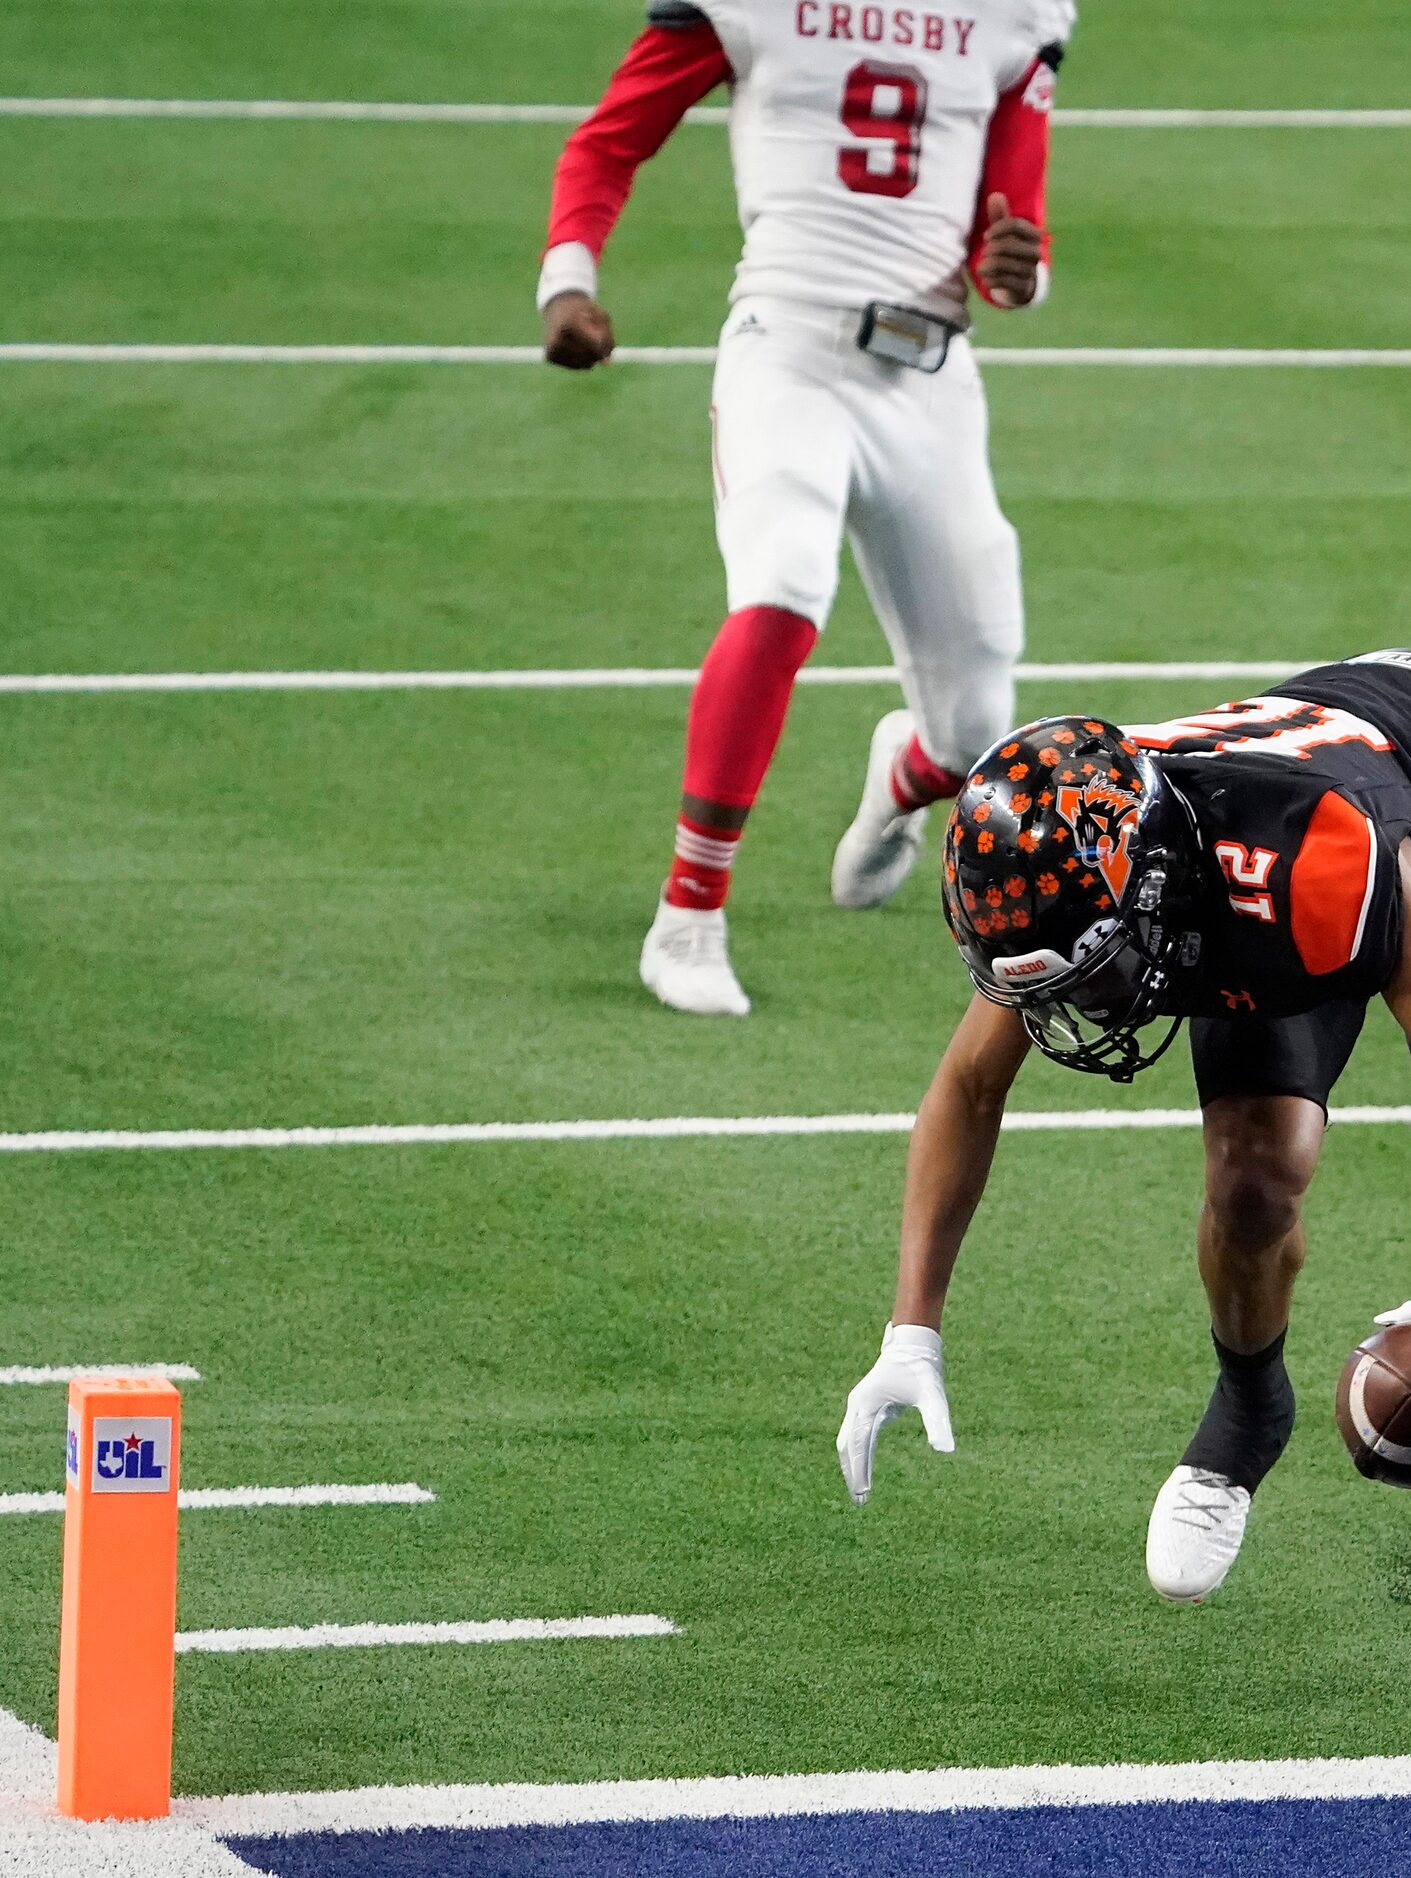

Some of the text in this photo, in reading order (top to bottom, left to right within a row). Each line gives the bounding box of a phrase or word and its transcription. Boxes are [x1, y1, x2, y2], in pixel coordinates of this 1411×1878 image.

[795, 0, 976, 57] CROSBY
[837, 58, 928, 199] 9
[1212, 839, 1280, 923] 12
[1003, 959, 1047, 976] ALEDO
